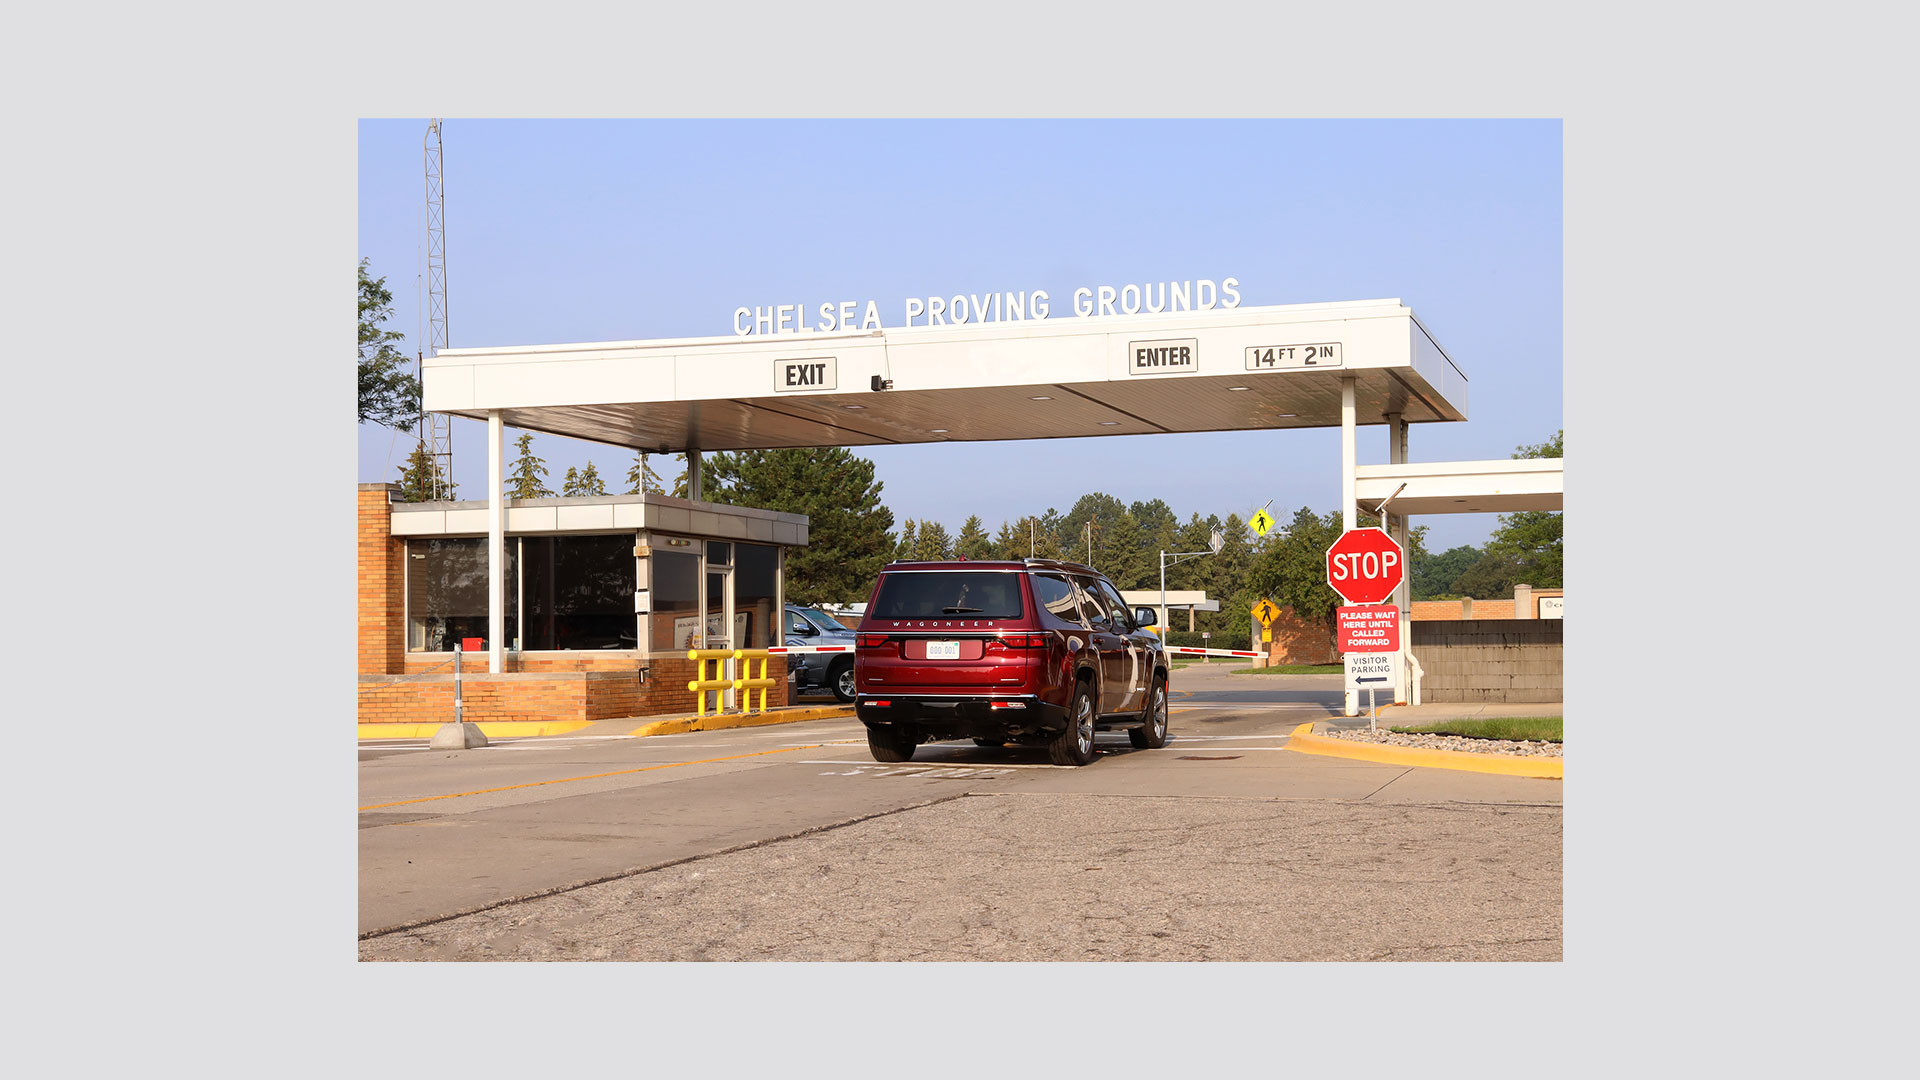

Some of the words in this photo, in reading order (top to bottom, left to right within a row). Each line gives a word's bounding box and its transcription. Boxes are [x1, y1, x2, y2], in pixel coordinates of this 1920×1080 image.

[734, 300, 883, 336] CHELSEA
[905, 290, 1050, 328] PROVING
[1073, 277, 1242, 318] GROUNDS
[1136, 346, 1191, 368] ENTER
[786, 363, 826, 386] EXIT
[1332, 551, 1398, 581] STOP
[1340, 612, 1373, 620] PLEASE
[1374, 611, 1396, 619] WAIT
[1343, 621, 1368, 629] HERE
[1368, 620, 1393, 628] UNTIL
[1353, 656, 1388, 665] VISITOR
[1351, 665, 1391, 674] PARKING
